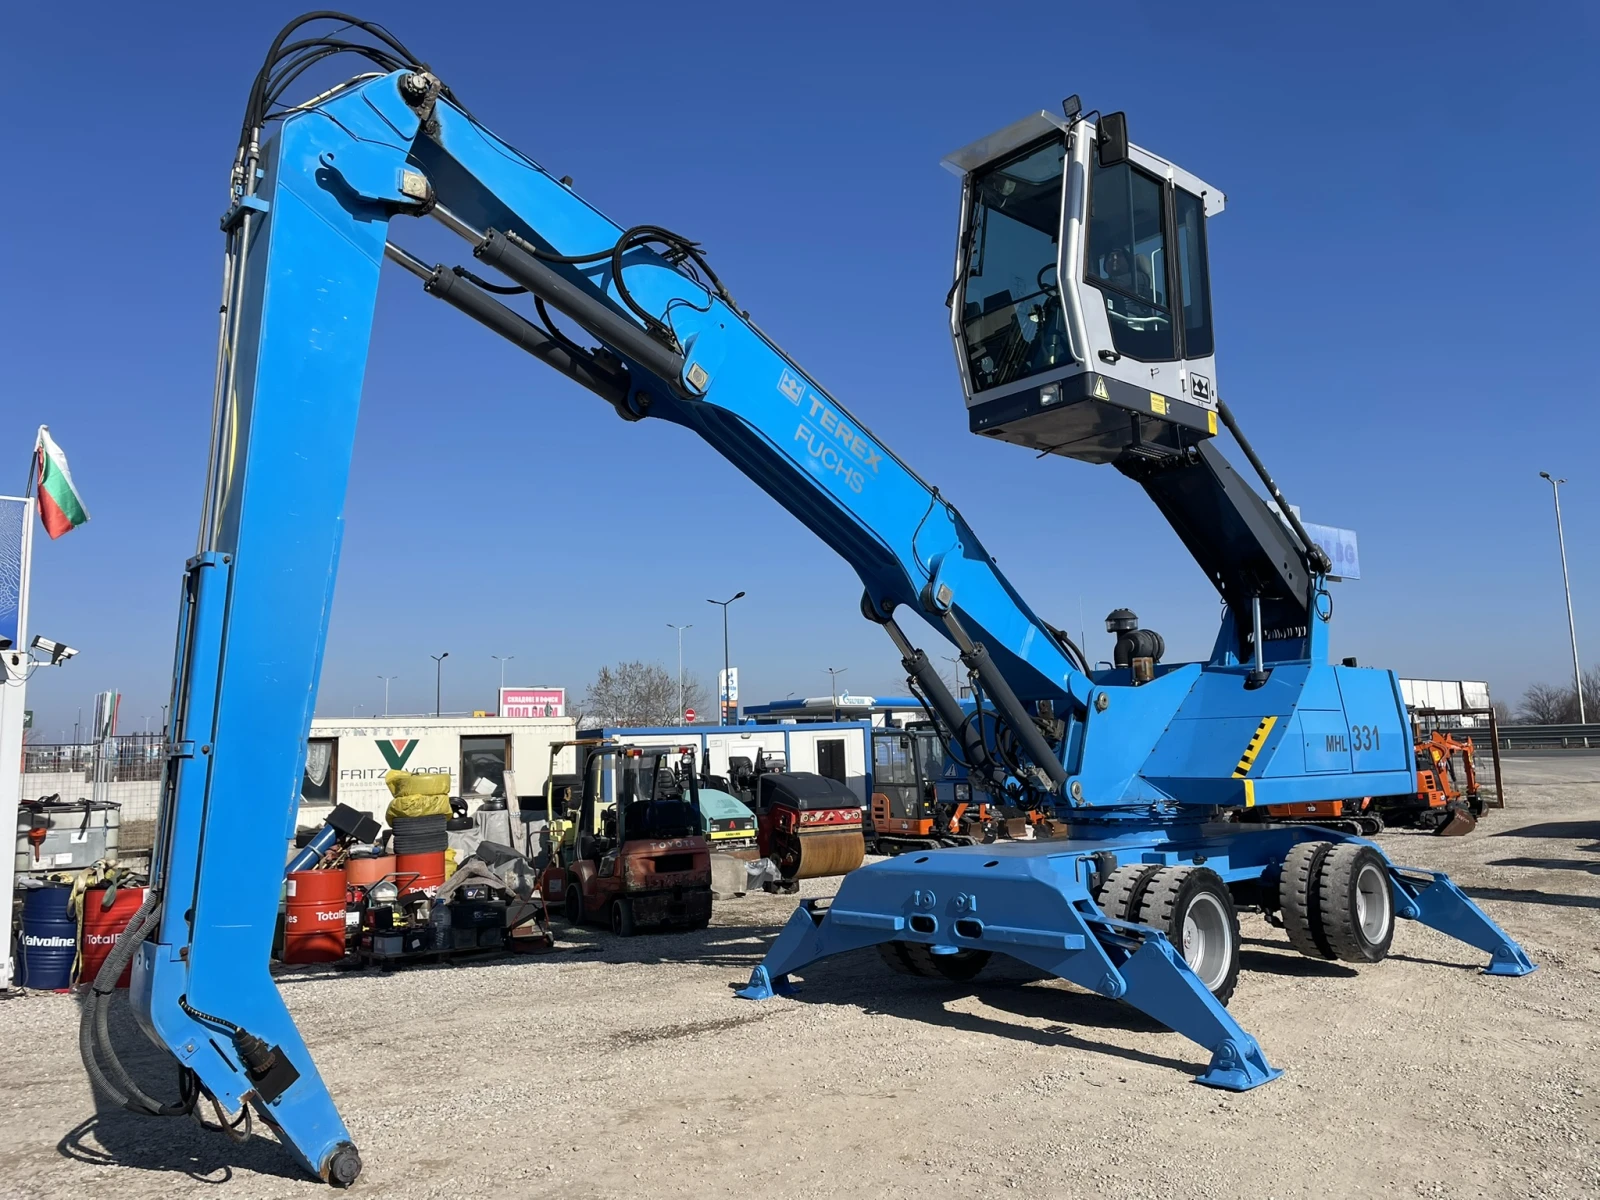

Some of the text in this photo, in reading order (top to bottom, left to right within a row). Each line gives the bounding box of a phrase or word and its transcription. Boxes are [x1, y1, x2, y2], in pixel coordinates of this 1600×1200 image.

[808, 393, 883, 474] TEREX
[793, 423, 865, 494] FUCHS
[507, 707, 529, 717] ПОД
[1326, 725, 1380, 752] MHL 331
[340, 766, 457, 780] FRITZ VOGEL
[650, 840, 696, 850] TOYOTA
[19, 930, 75, 947] Valvoline
